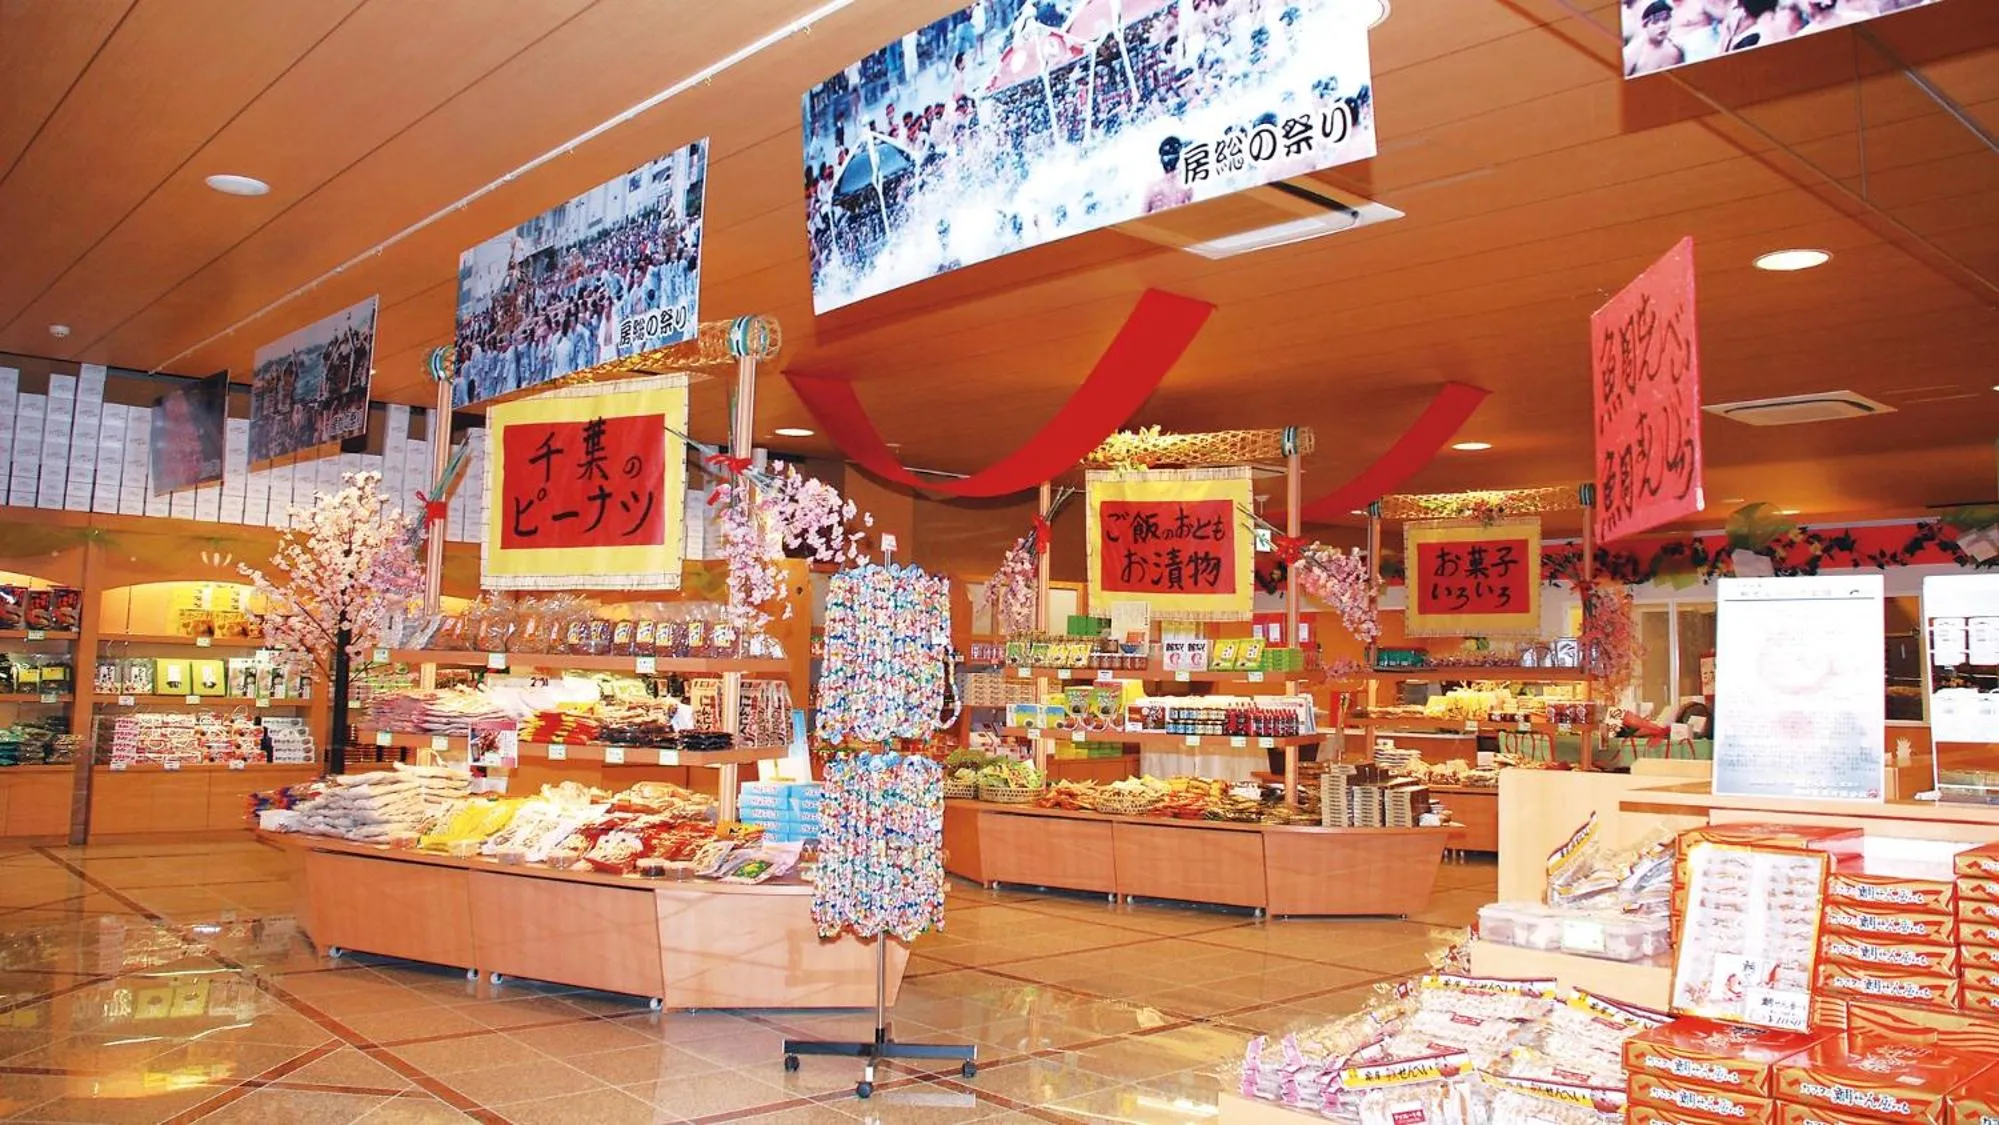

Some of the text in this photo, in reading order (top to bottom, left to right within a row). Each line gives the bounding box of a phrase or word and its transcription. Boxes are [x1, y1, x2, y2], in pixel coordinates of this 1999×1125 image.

[1184, 106, 1347, 185] 房総の祭り
[619, 305, 687, 346] 房総の祭り
[528, 415, 642, 484] 千葉の
[513, 485, 654, 538] ピーナツ
[1105, 506, 1226, 545] ご飯のおとも
[1120, 546, 1222, 591] お漬物
[1433, 546, 1519, 580] お菓子
[1430, 582, 1512, 611] いろいろ
